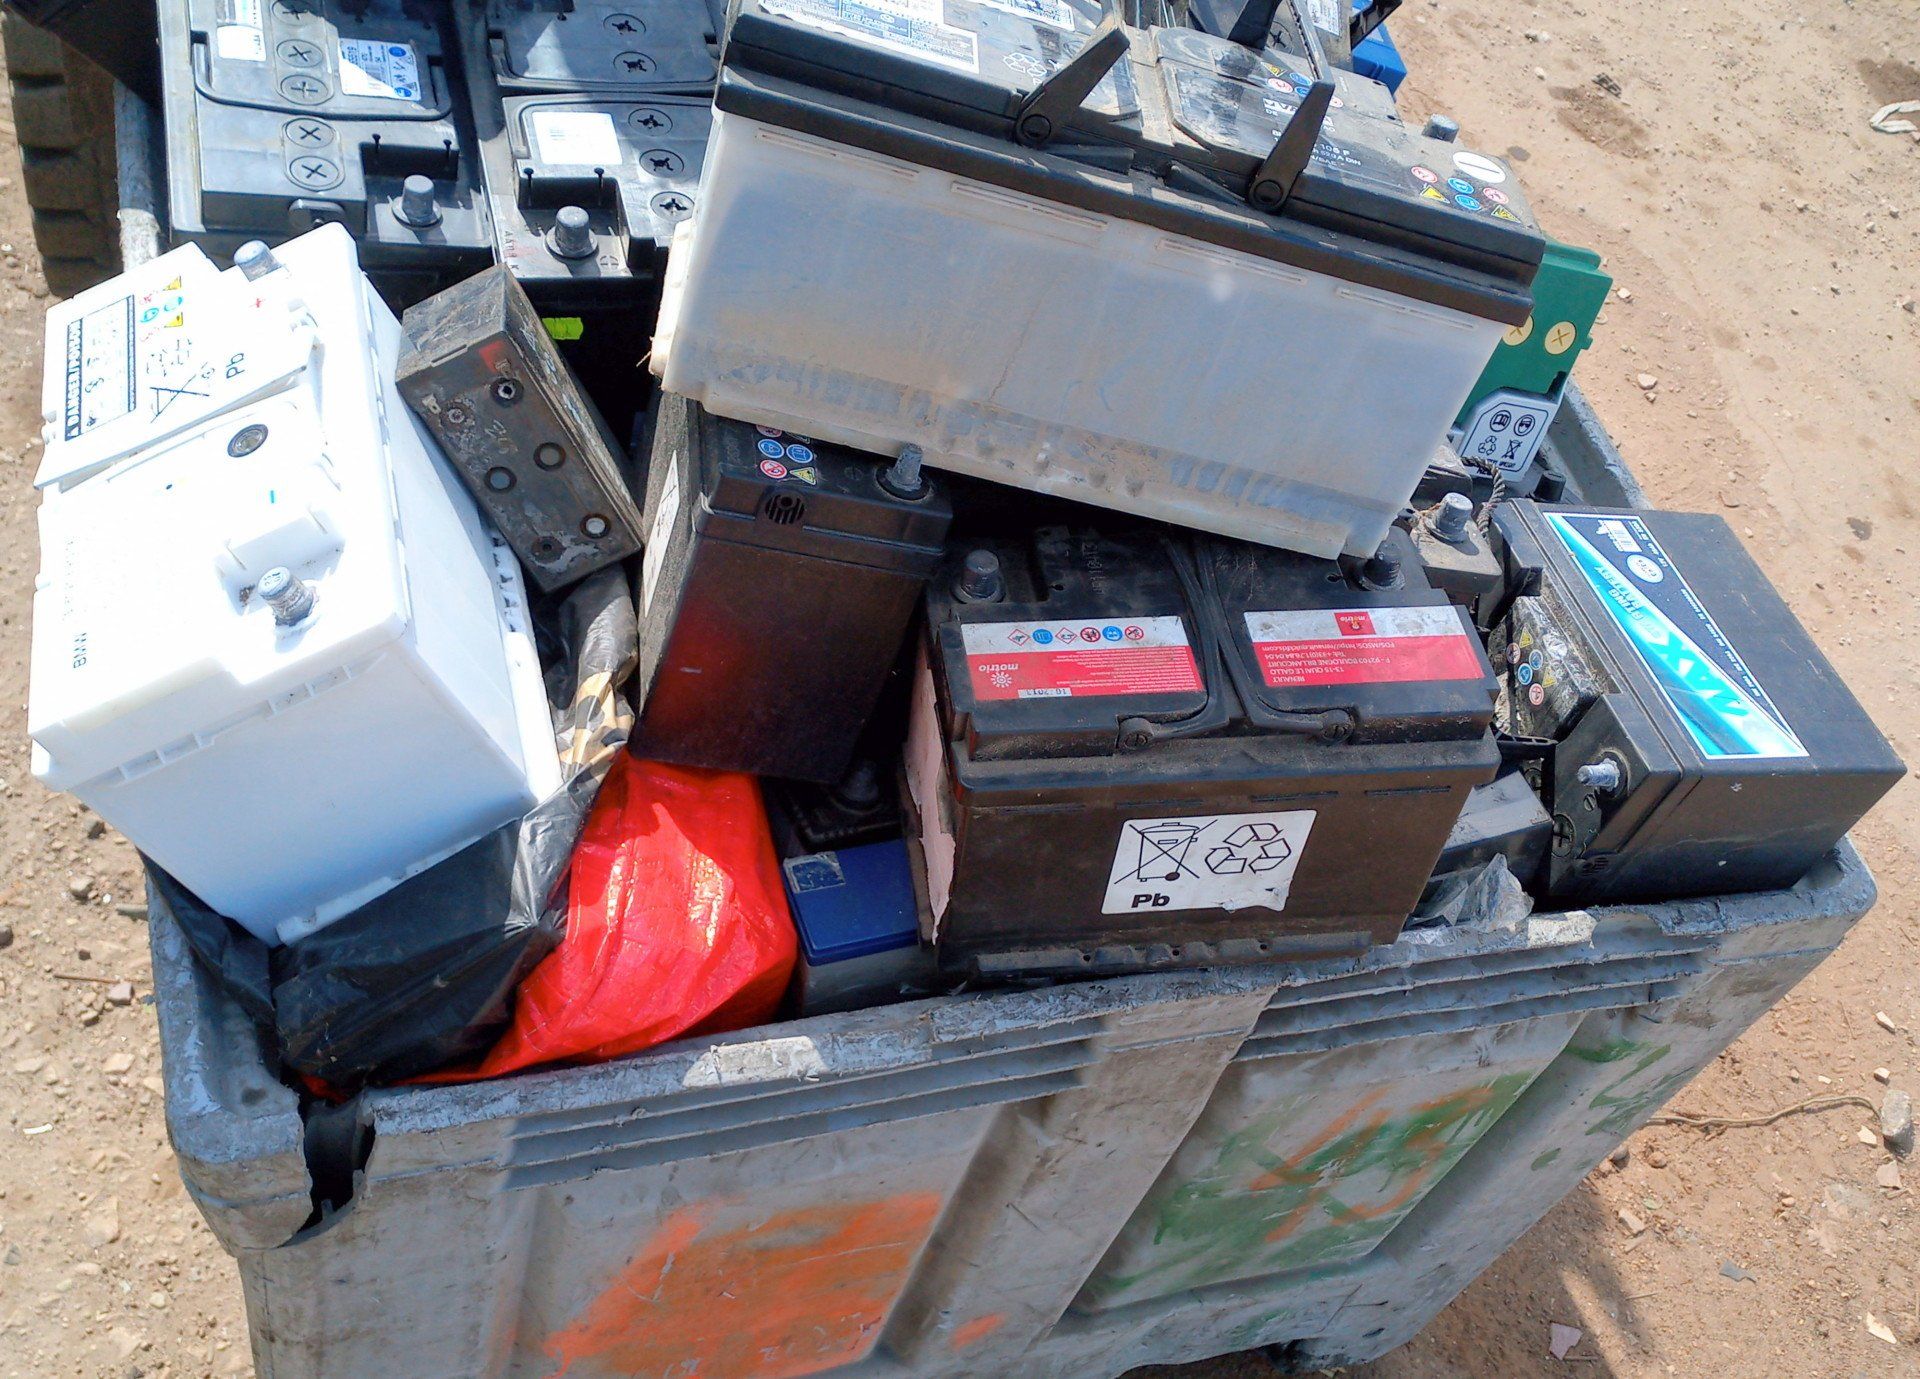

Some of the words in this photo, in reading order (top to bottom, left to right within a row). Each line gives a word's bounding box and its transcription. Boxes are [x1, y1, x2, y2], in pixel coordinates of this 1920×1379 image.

[225, 352, 245, 379] Pb
[72, 633, 87, 668] BMW
[979, 663, 1019, 672] motrio
[1131, 893, 1170, 908] Pb
